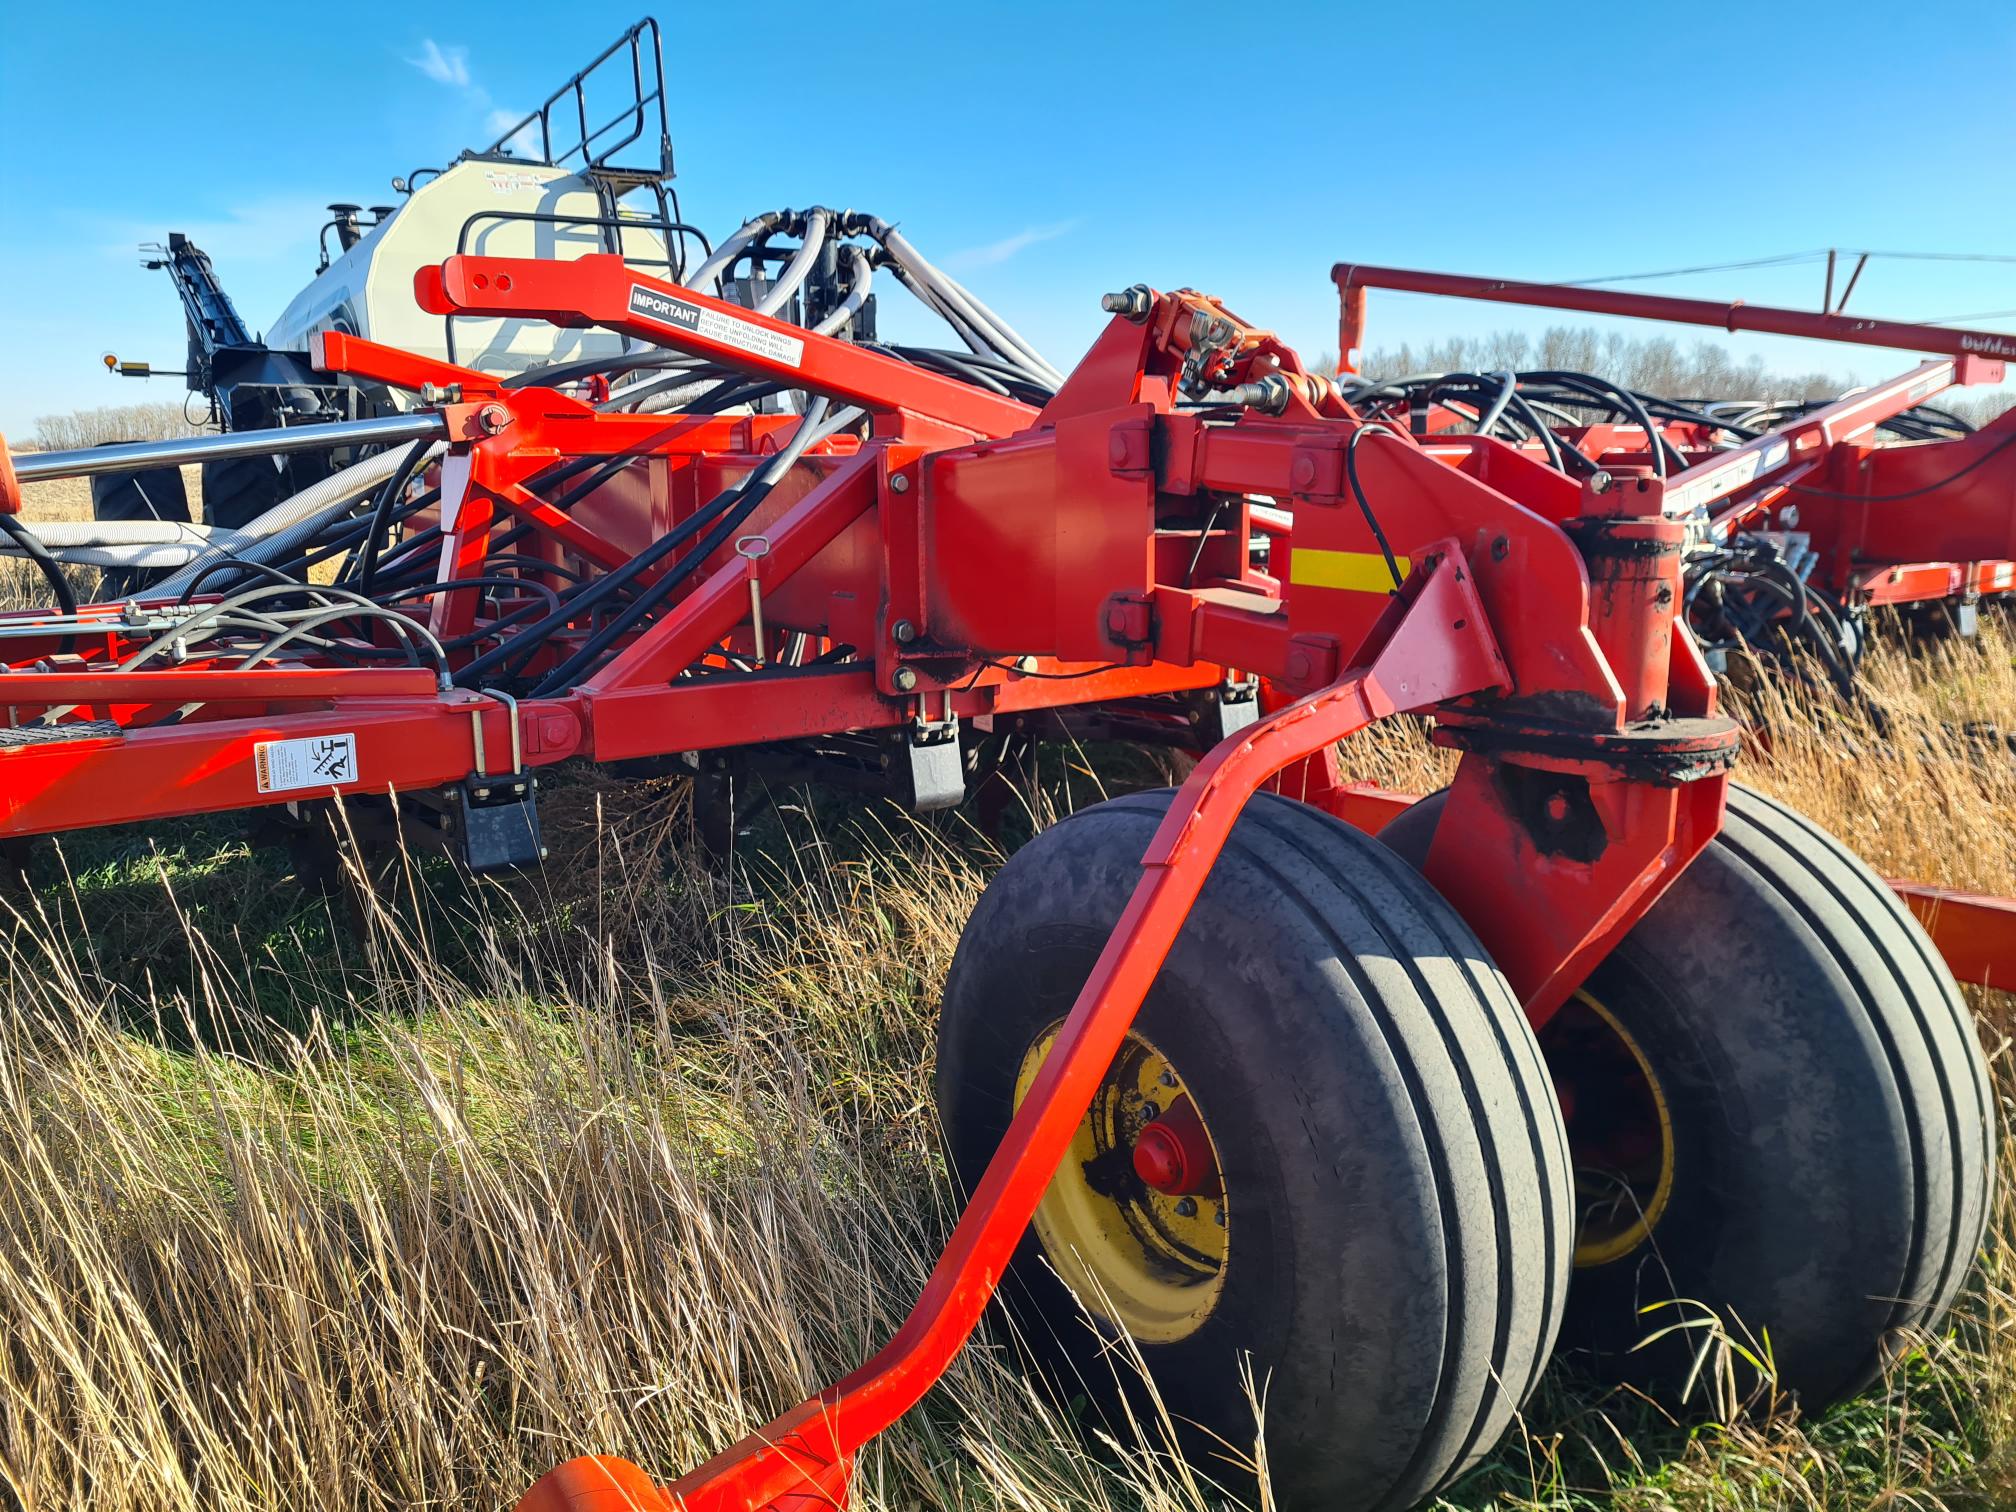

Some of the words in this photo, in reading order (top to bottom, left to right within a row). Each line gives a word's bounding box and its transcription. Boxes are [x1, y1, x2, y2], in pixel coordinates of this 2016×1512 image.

[632, 292, 698, 324] IMPORTANT
[699, 327, 723, 339] CAUSE
[723, 334, 767, 354] STRUCTURAL
[700, 319, 728, 333] BEFORE
[729, 327, 767, 345] UNFOLDING
[768, 339, 784, 351] WILL
[701, 310, 730, 325] FAILURE
[742, 324, 769, 339] UNLOCK
[770, 334, 792, 346] WINGS
[257, 745, 269, 781] WARNING
